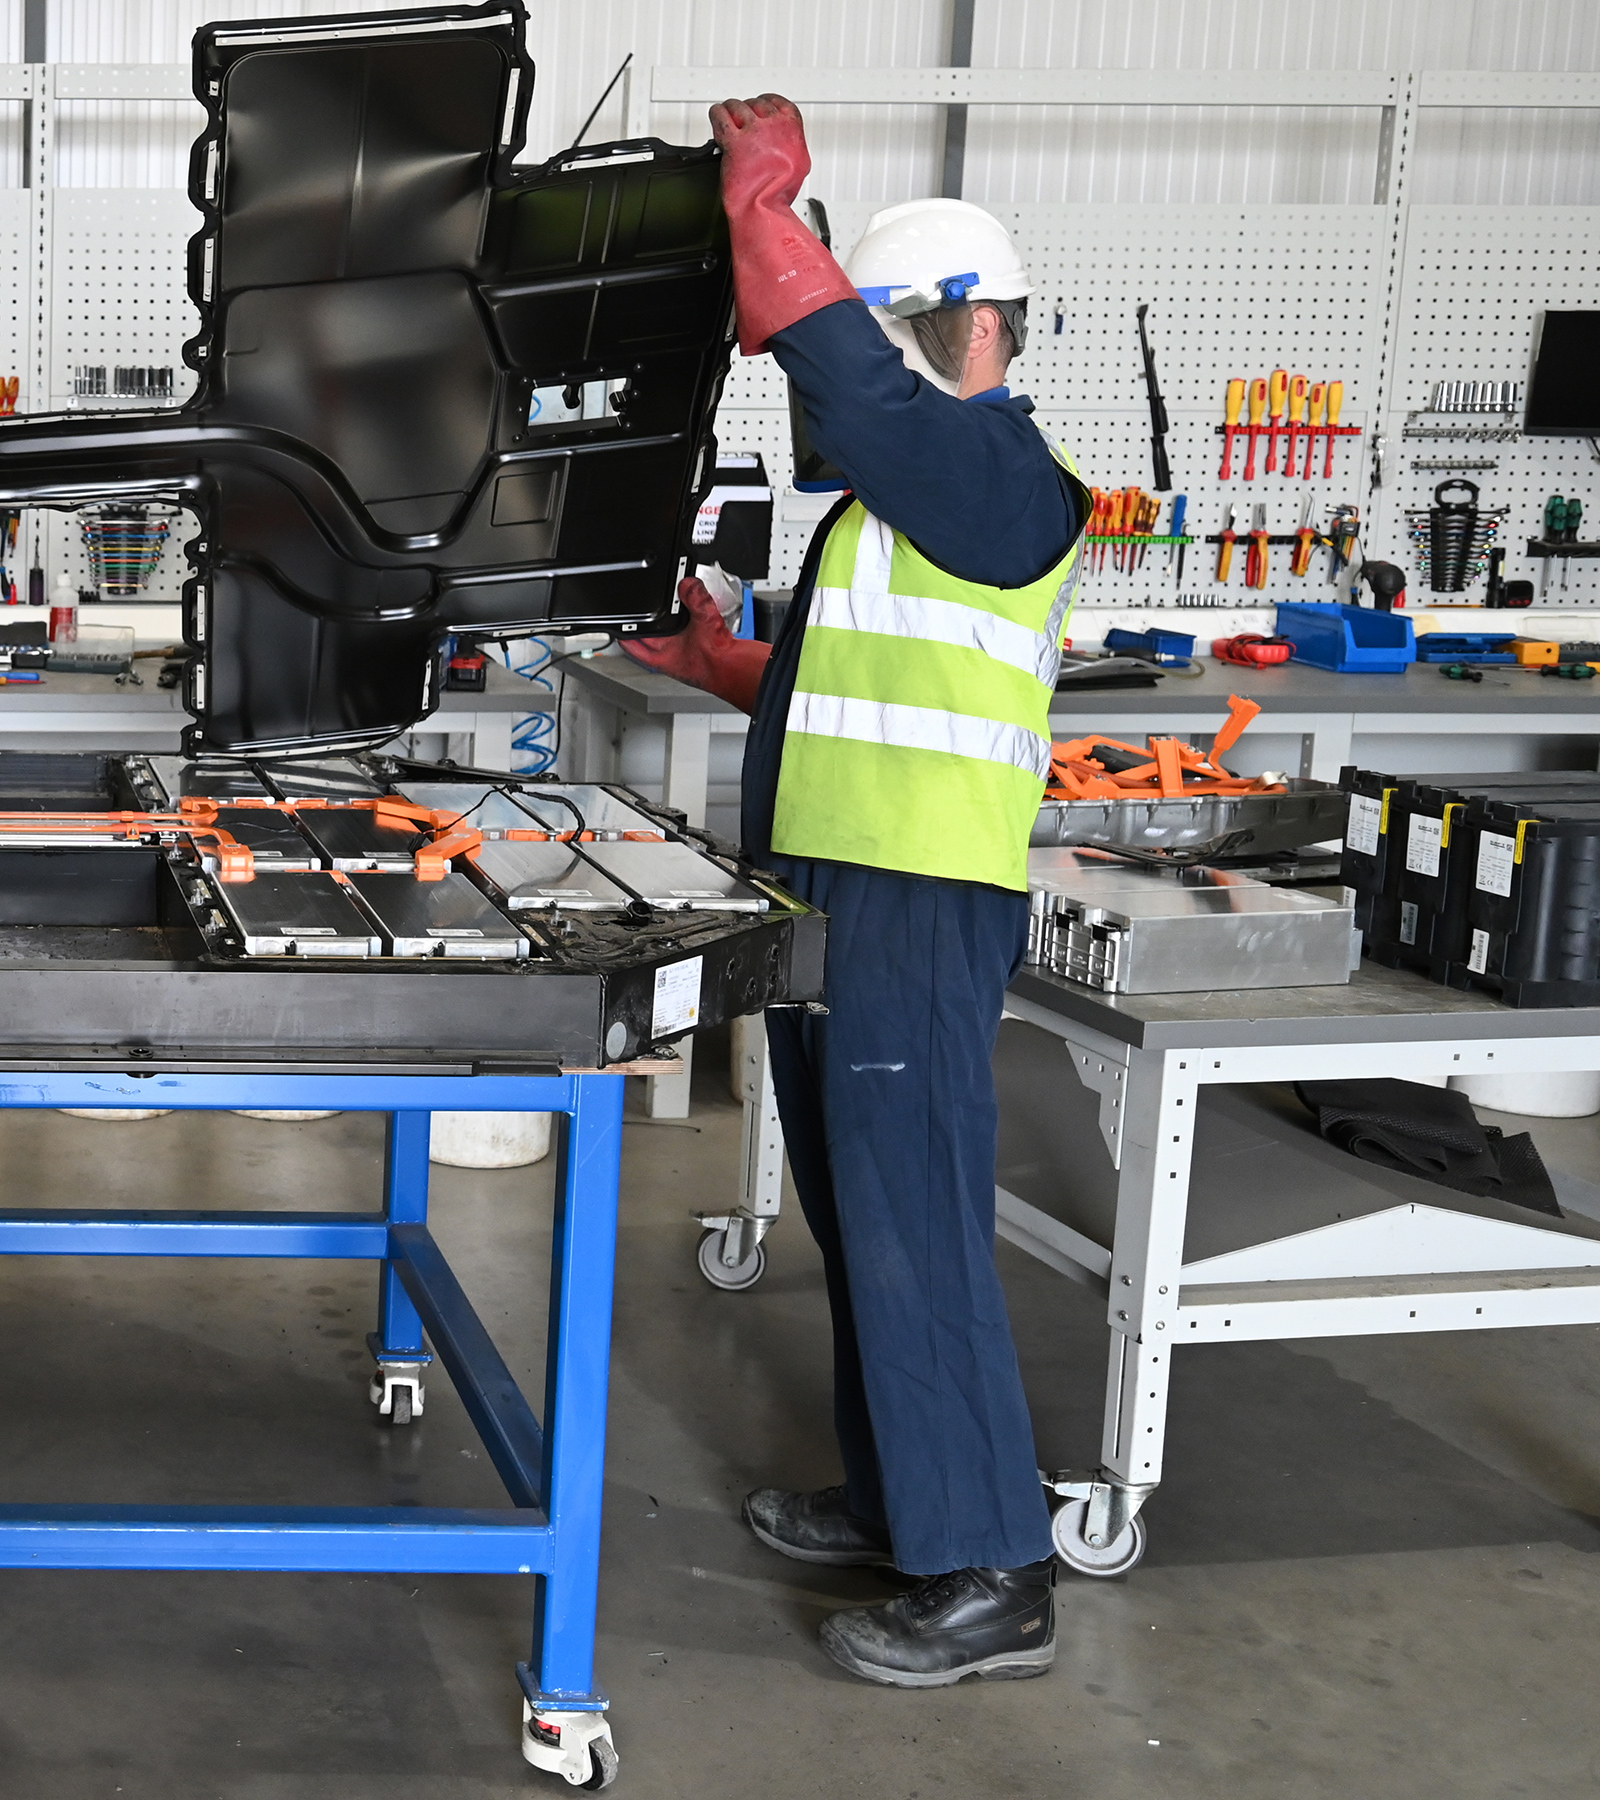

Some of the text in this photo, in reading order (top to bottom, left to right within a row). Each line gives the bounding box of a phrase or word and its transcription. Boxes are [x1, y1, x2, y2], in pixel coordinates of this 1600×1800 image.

[778, 274, 789, 283] JUL
[788, 269, 797, 278] 20
[699, 506, 721, 515] NGE
